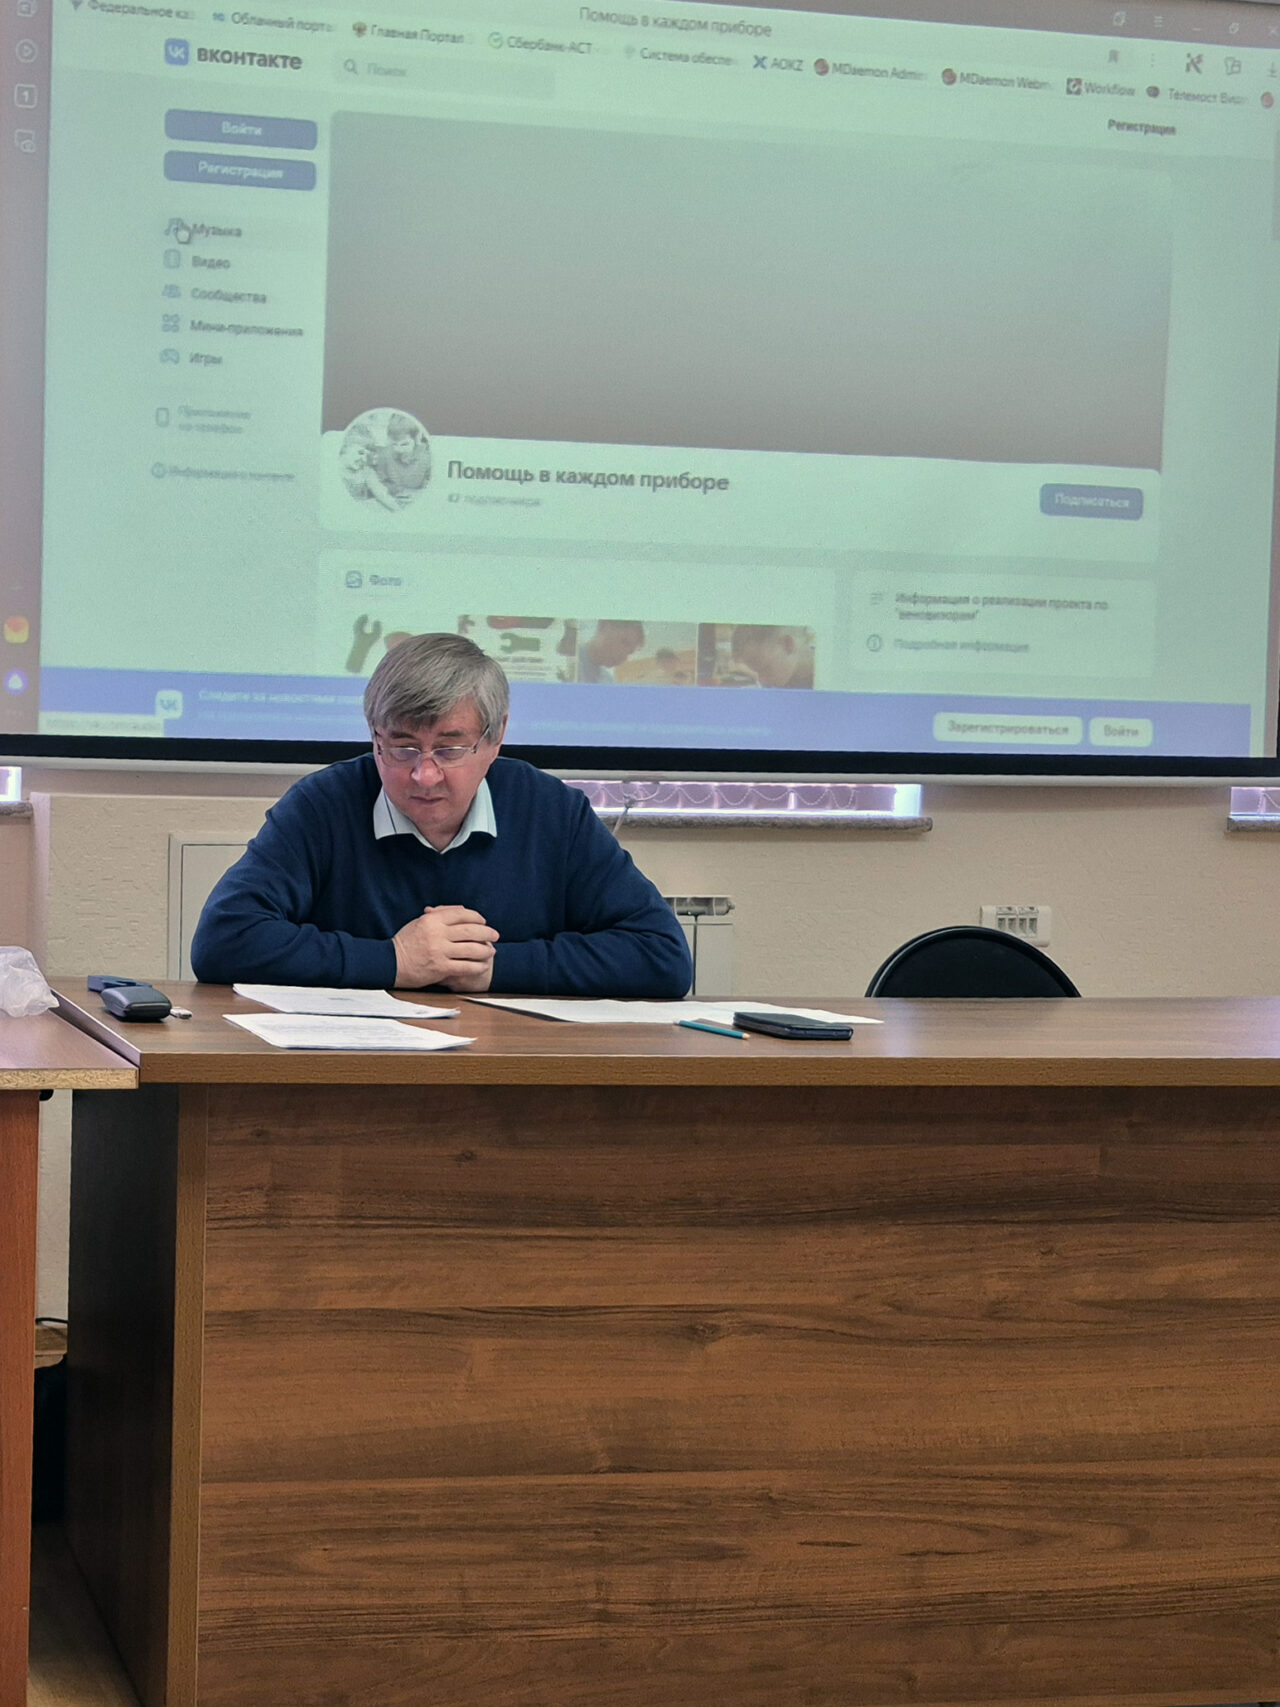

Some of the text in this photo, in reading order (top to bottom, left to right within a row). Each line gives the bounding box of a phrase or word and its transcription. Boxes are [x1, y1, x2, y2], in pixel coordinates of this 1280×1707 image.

[580, 6, 773, 38] Помощь в каждом приборе
[639, 47, 690, 63] Система
[1084, 80, 1136, 97] Workflow
[221, 119, 263, 137] Войти
[1107, 117, 1177, 138] Регистрация
[197, 159, 285, 180] Регистрация
[191, 222, 243, 239] Музыка
[191, 254, 232, 271] Видео
[190, 286, 268, 306] Сообщества
[188, 350, 223, 368] Игры
[447, 459, 731, 495] Помощь в каждом приборе
[1103, 721, 1140, 739] Войти
